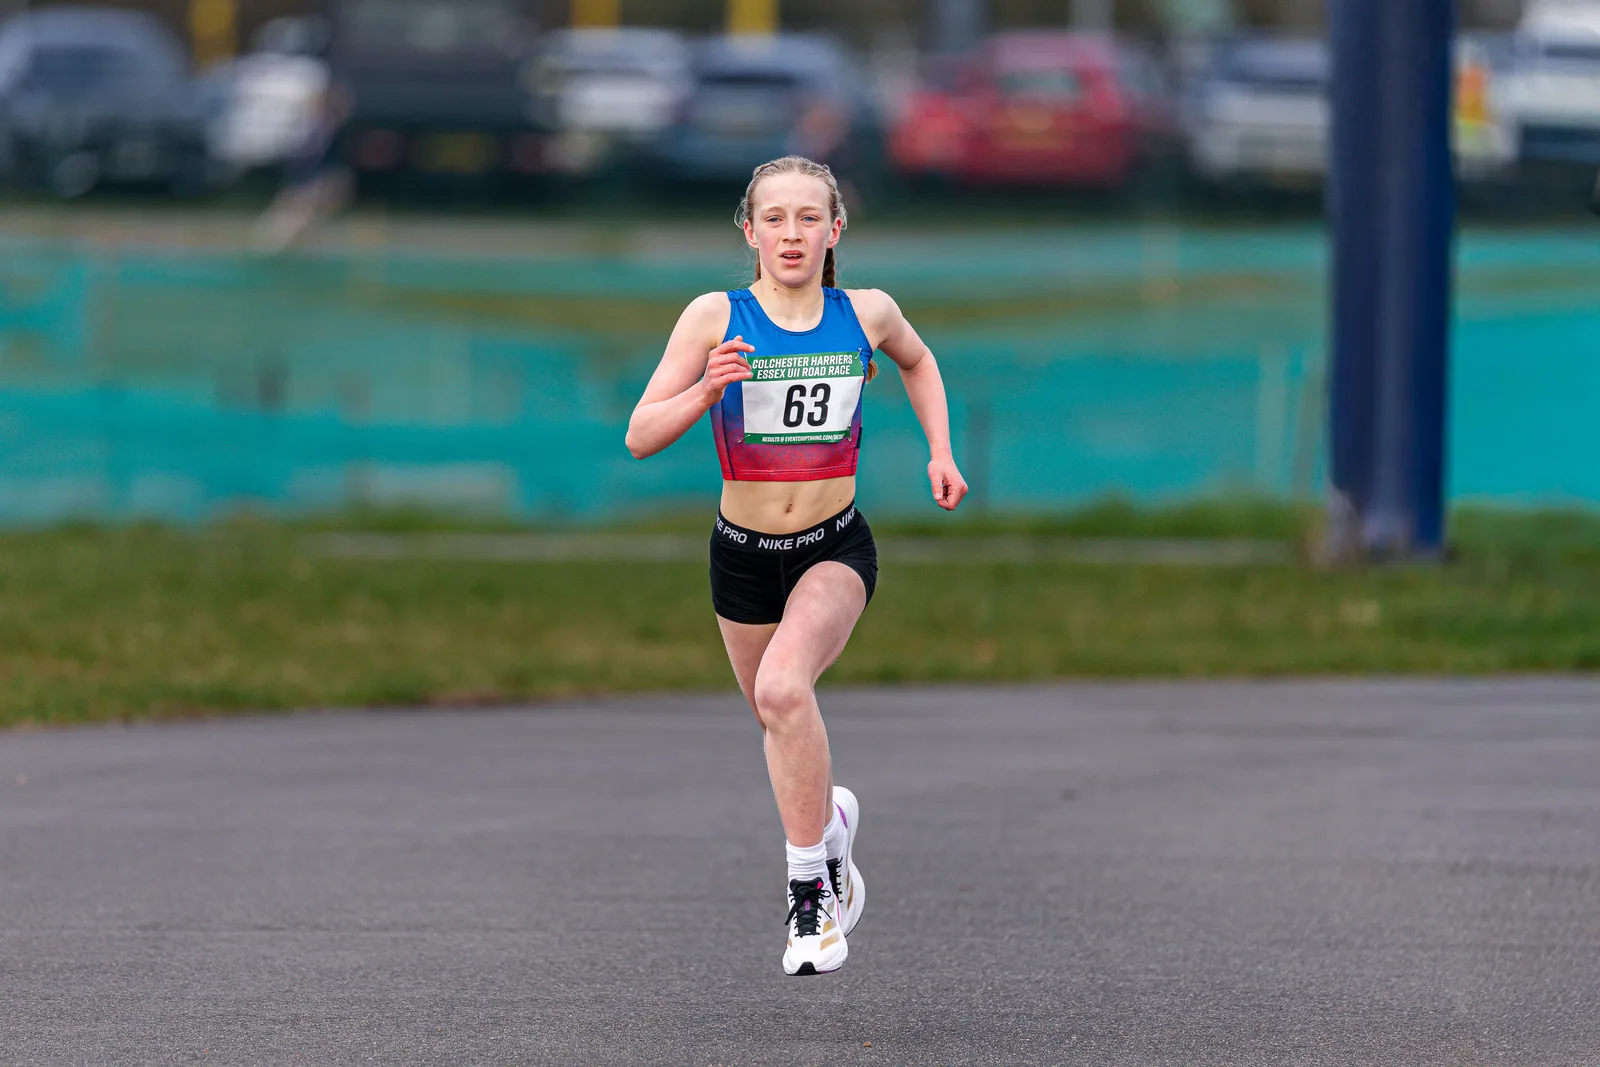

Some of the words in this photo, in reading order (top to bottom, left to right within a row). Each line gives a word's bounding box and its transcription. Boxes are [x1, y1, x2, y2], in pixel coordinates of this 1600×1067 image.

[752, 356, 809, 369] COLCHESTER
[811, 354, 853, 366] HARRIERS
[757, 368, 785, 380] ESSEX
[802, 366, 826, 378] ROAD
[828, 365, 851, 376] RACE
[783, 383, 831, 427] 63
[723, 525, 748, 544] PRO
[758, 537, 794, 550] NIKE
[796, 528, 825, 548] PRO
